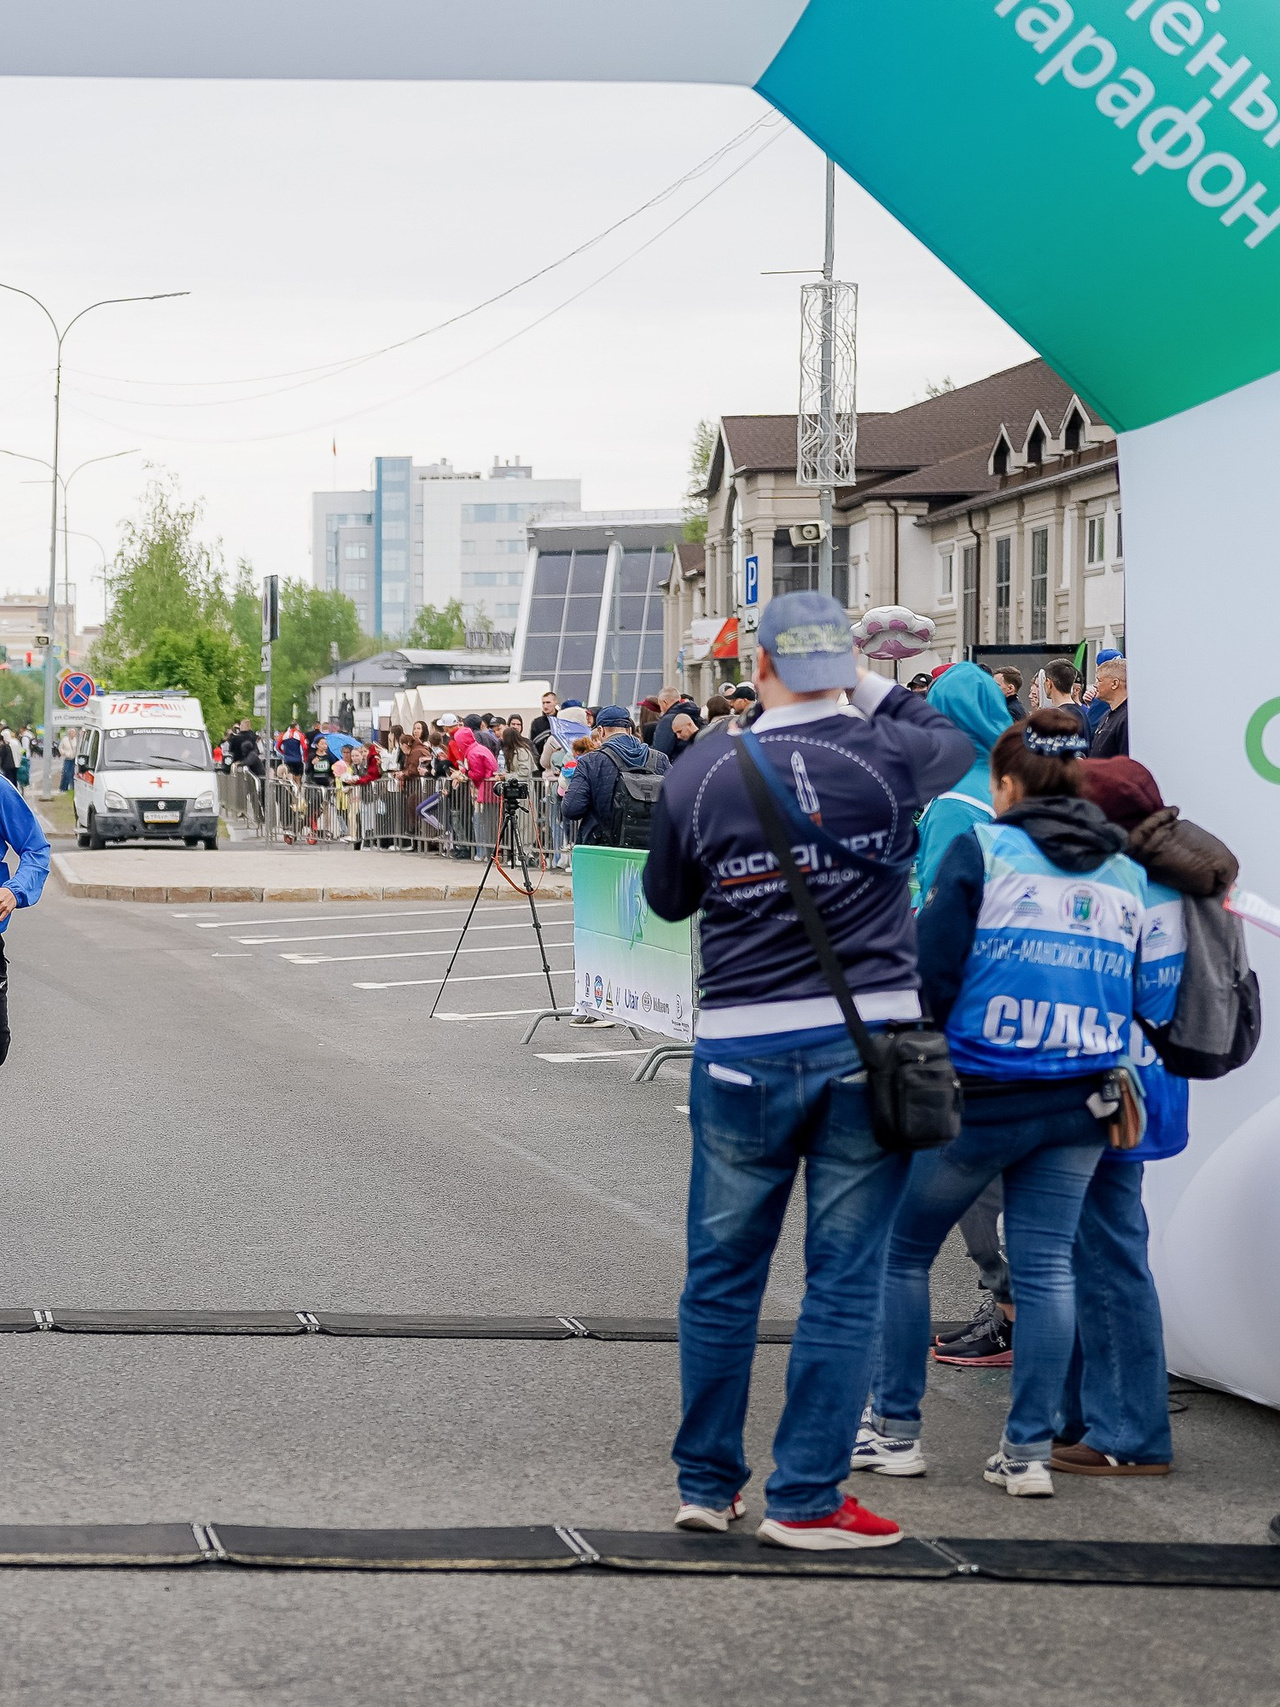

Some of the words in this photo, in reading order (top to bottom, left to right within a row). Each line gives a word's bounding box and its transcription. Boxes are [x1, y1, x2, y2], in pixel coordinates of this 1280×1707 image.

[993, 0, 1280, 250] арафон
[110, 703, 141, 715] 103
[109, 729, 126, 738] 03
[182, 729, 199, 738] 03
[624, 988, 639, 1011] Utair
